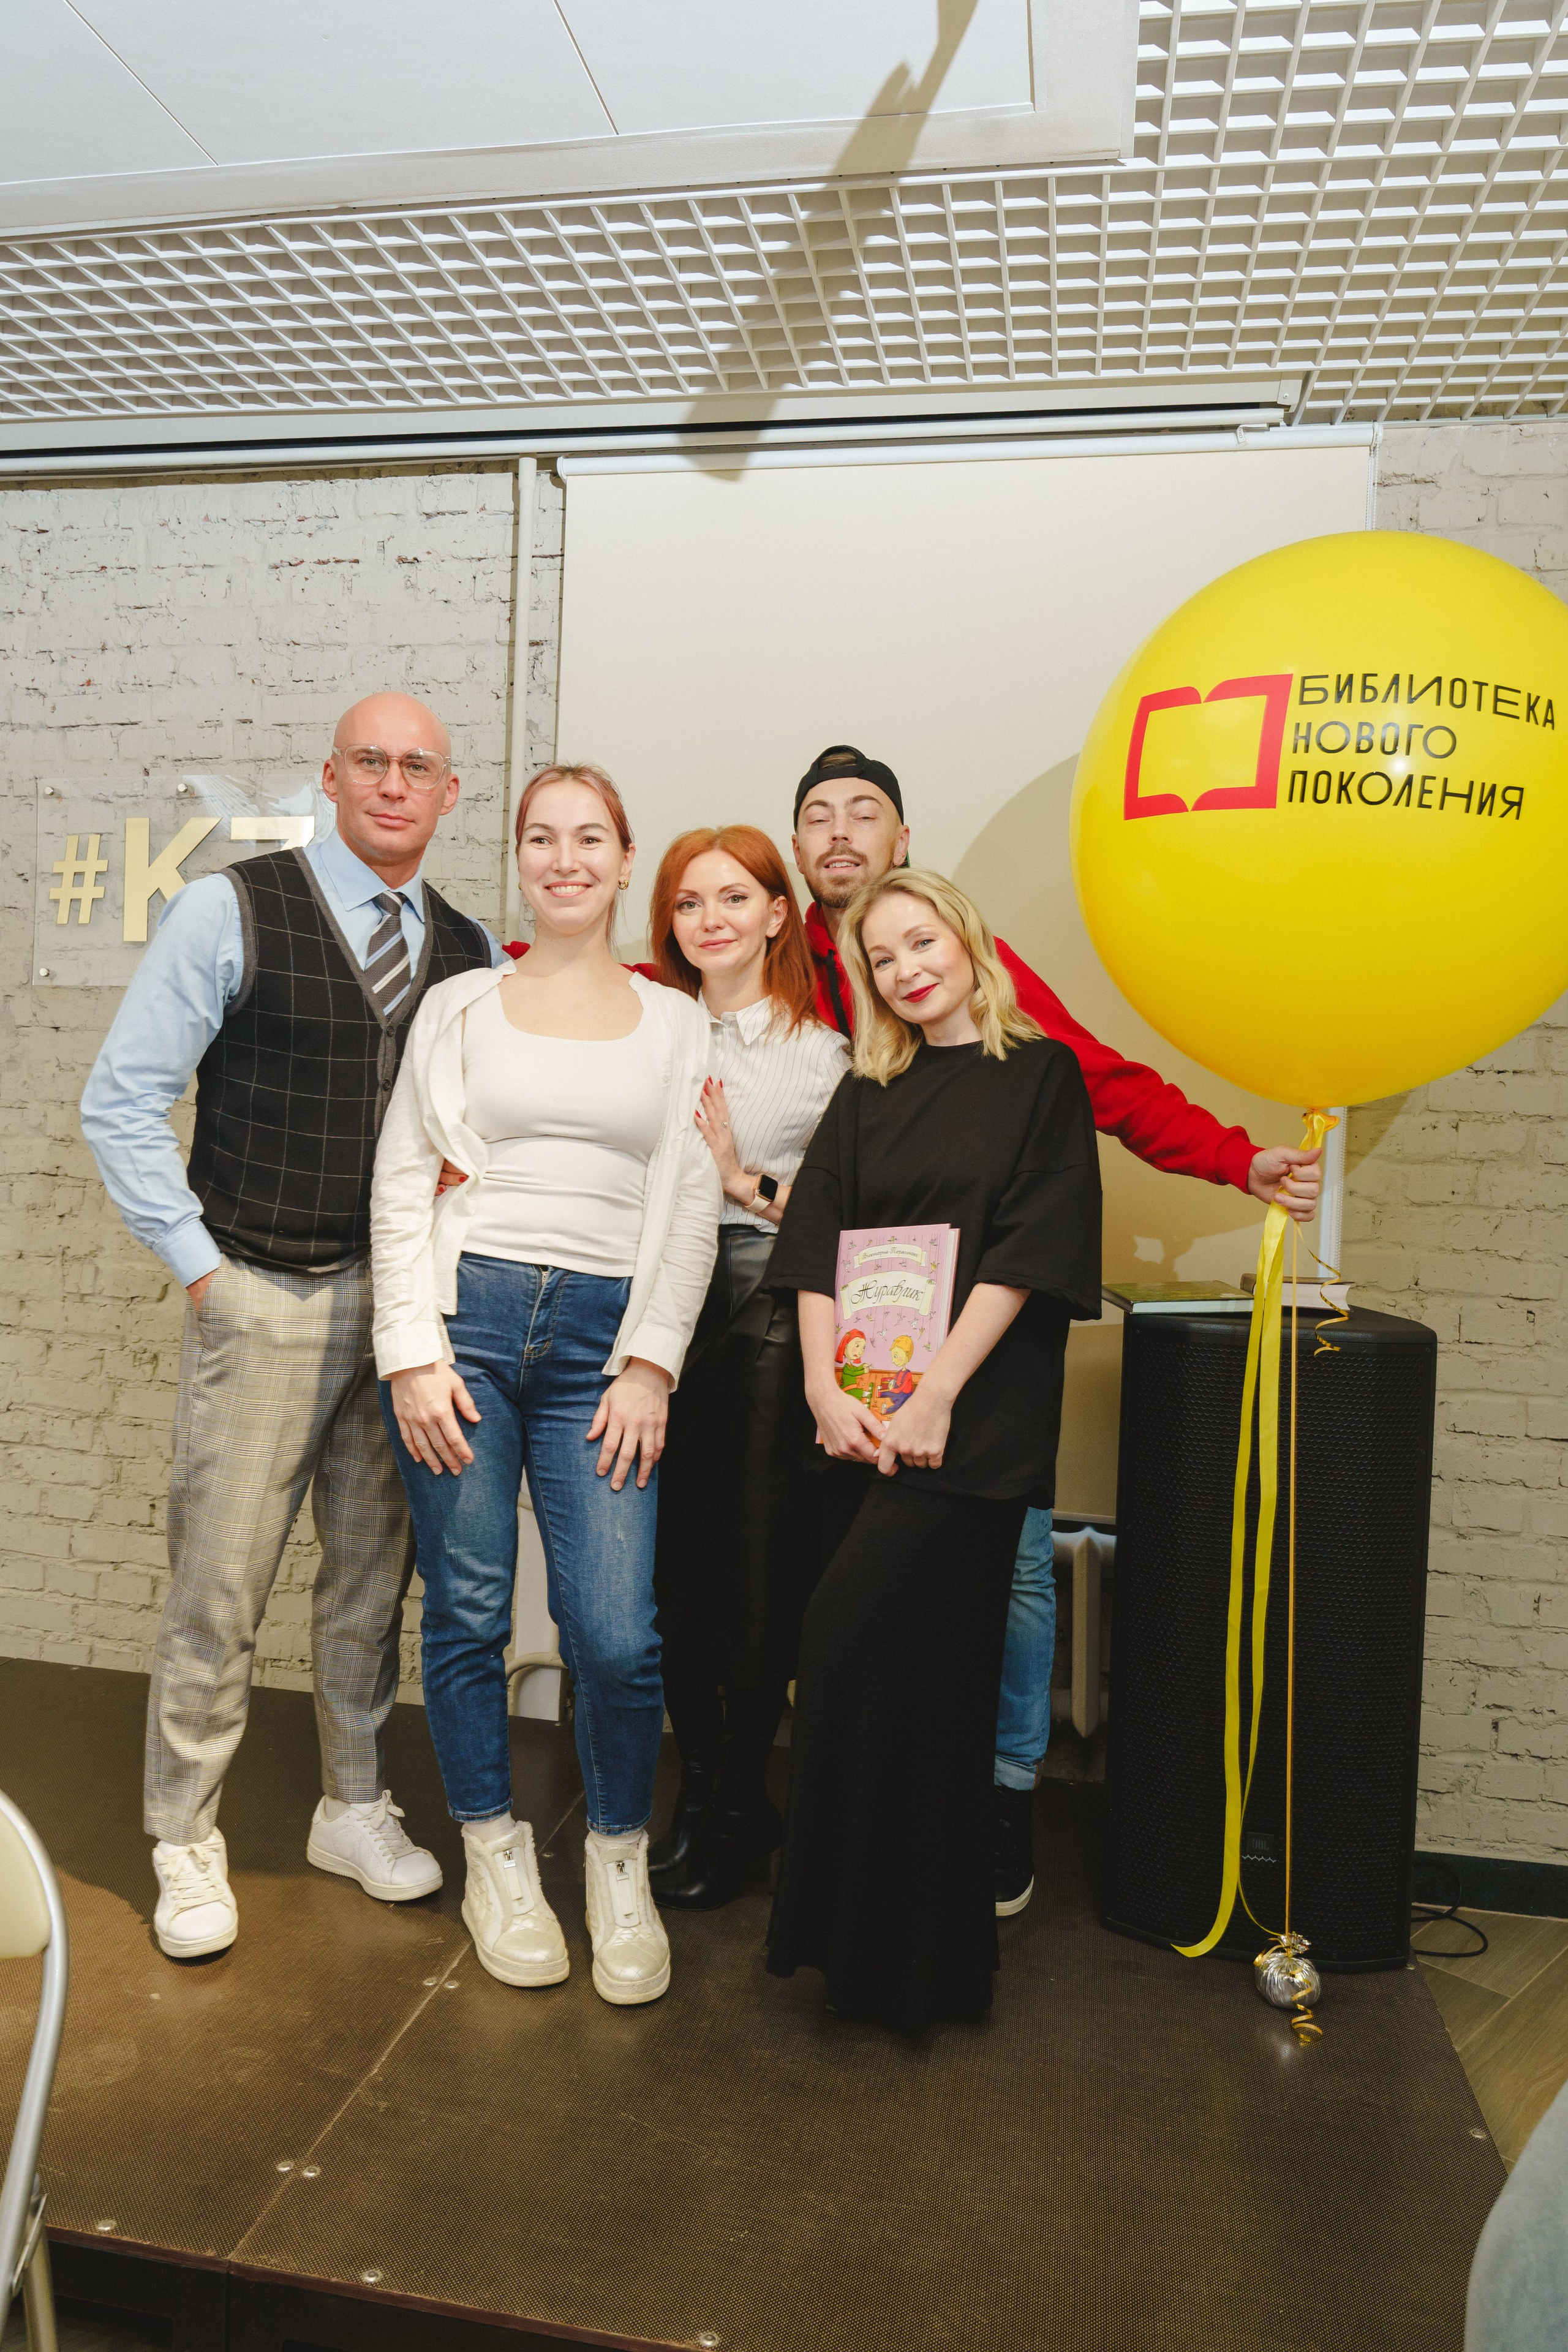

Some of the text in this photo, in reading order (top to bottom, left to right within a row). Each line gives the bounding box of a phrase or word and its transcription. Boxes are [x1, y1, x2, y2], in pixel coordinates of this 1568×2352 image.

[1298, 673, 1556, 731] БИБЛИОТЕКА
[1292, 720, 1457, 760] НОВОГО
[1287, 770, 1525, 820] ПОКОЛЕНИЯ
[862, 1251, 889, 1260] Виктория
[850, 1279, 924, 1305] Журавлик
